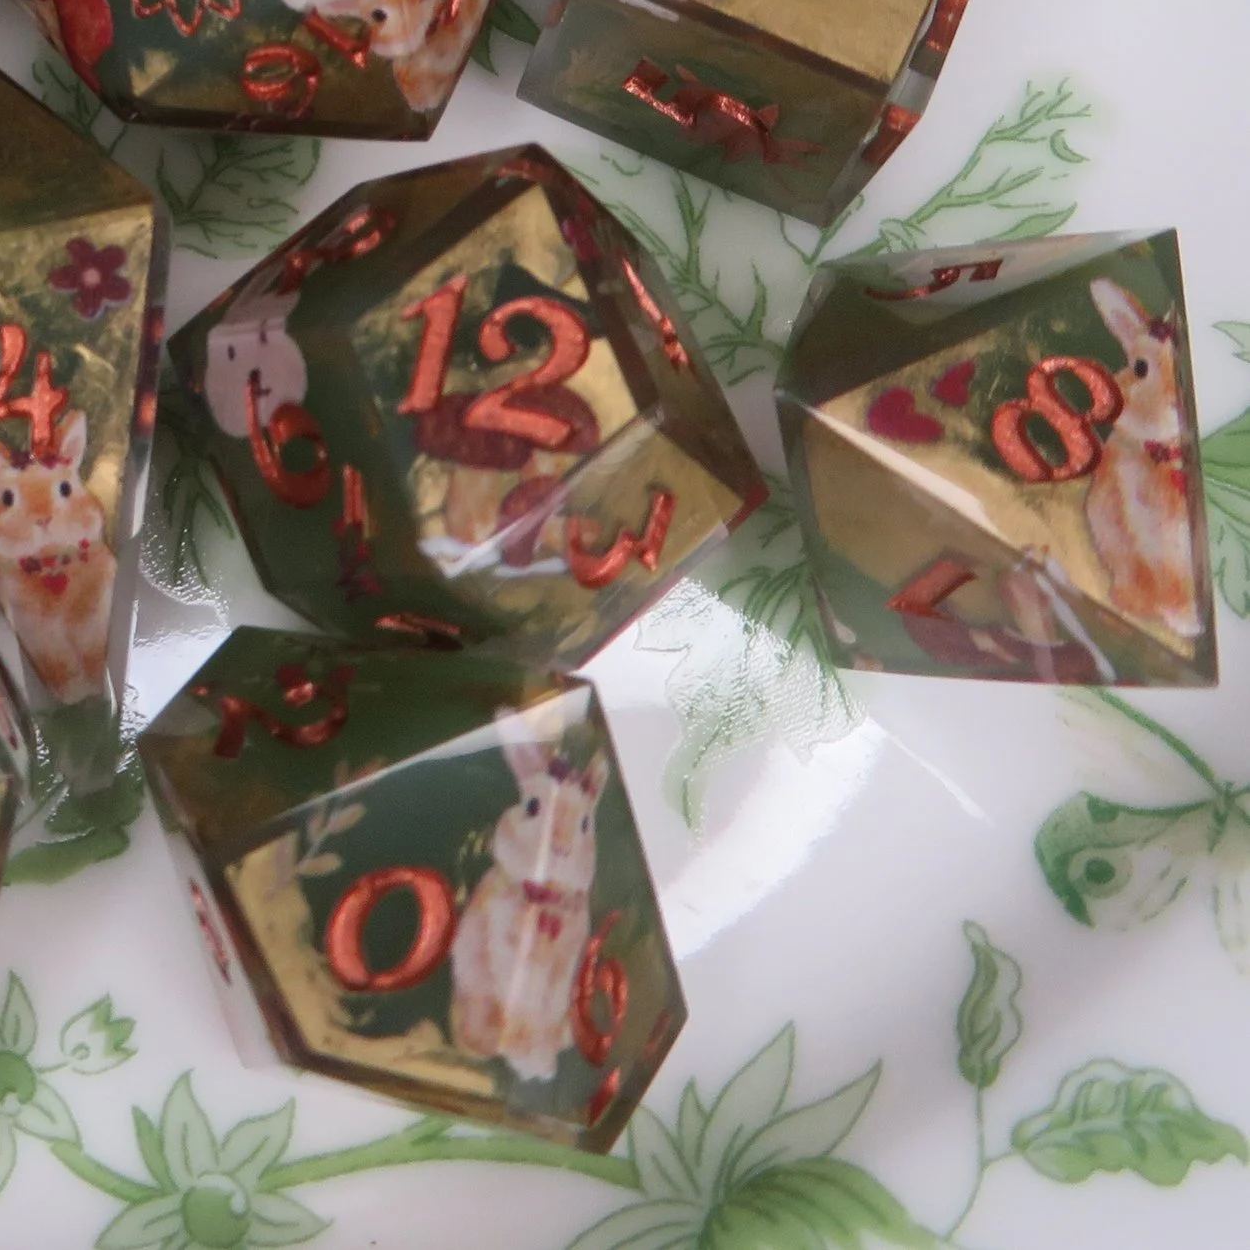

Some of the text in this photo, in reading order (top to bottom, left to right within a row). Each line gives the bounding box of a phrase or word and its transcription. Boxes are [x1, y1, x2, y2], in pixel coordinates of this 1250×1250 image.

[396, 273, 592, 448] 12
[990, 355, 1126, 486] 8
[325, 866, 457, 993] 0
[570, 910, 630, 1068] 6
